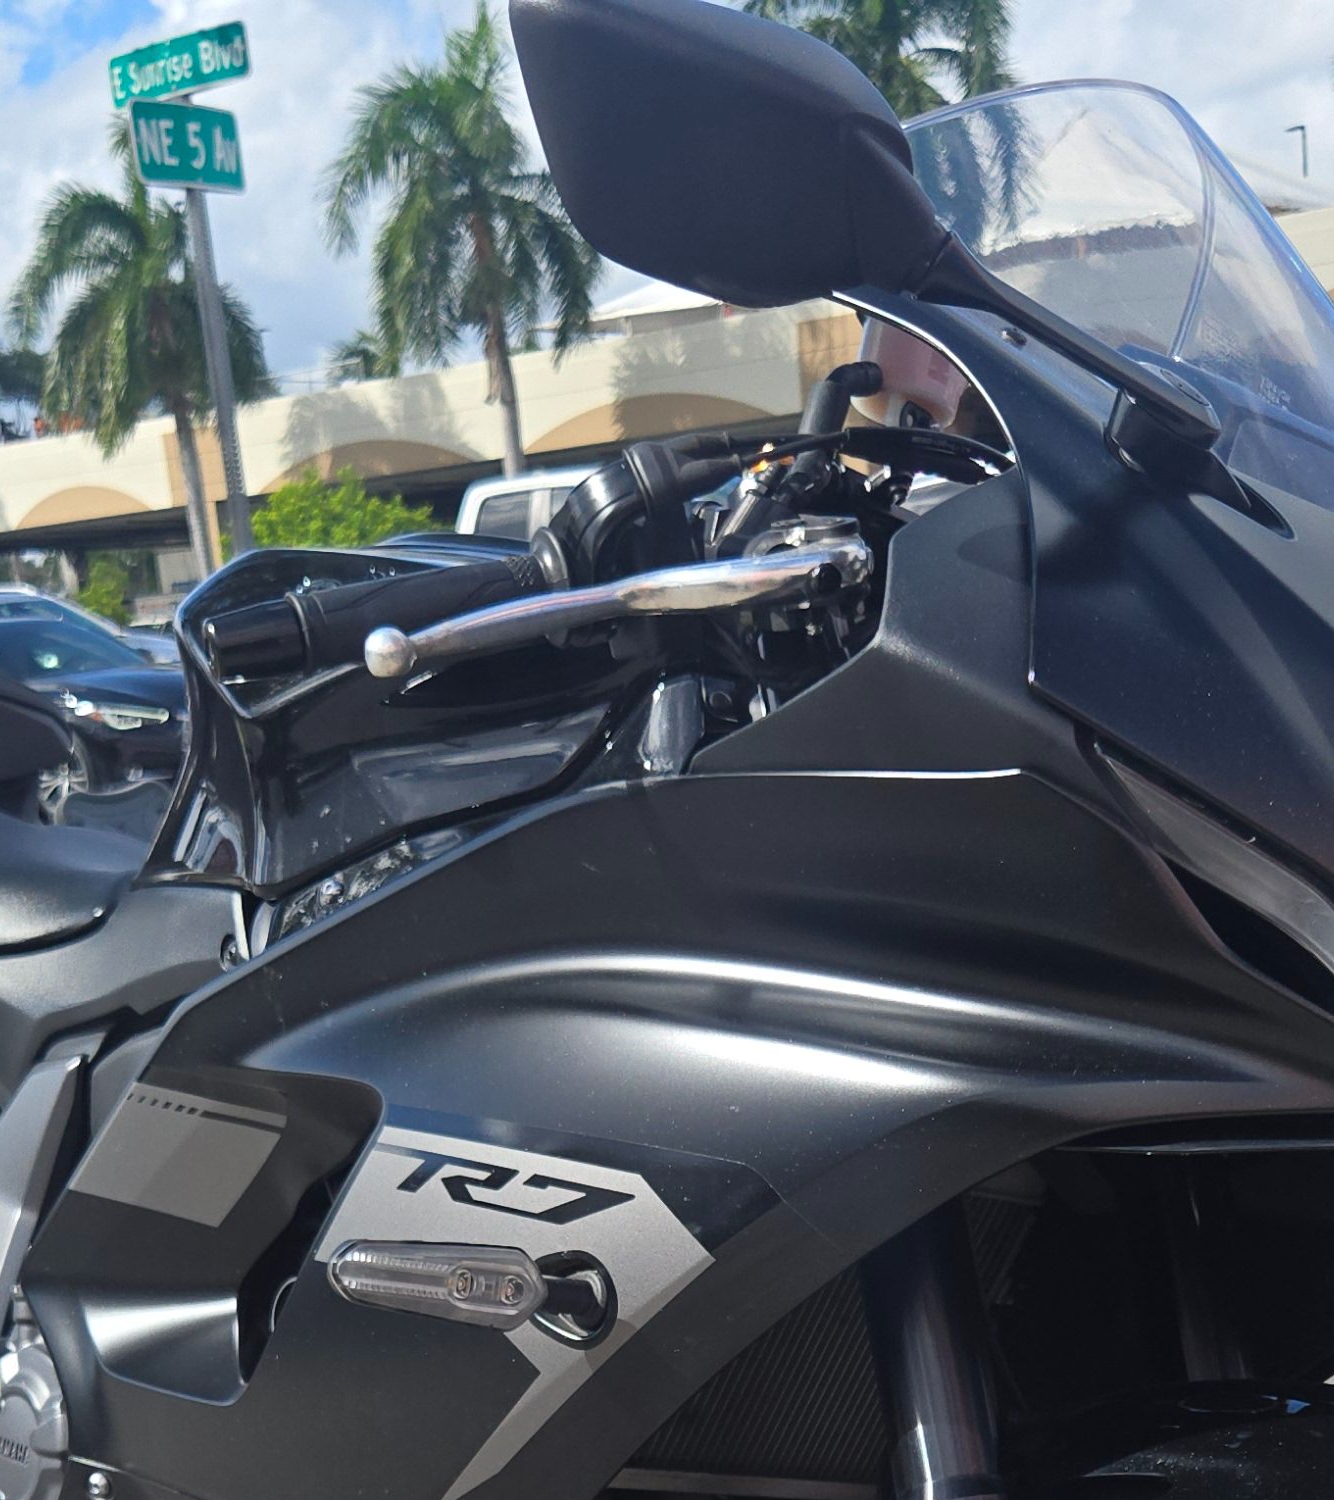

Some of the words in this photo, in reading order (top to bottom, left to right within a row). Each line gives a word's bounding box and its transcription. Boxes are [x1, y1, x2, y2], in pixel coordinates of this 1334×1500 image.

[113, 65, 126, 100] E
[128, 53, 193, 94] Sunrise
[198, 35, 245, 75] Blvd
[138, 118, 180, 167] NE
[186, 121, 206, 170] 5
[376, 1143, 637, 1225] R7
